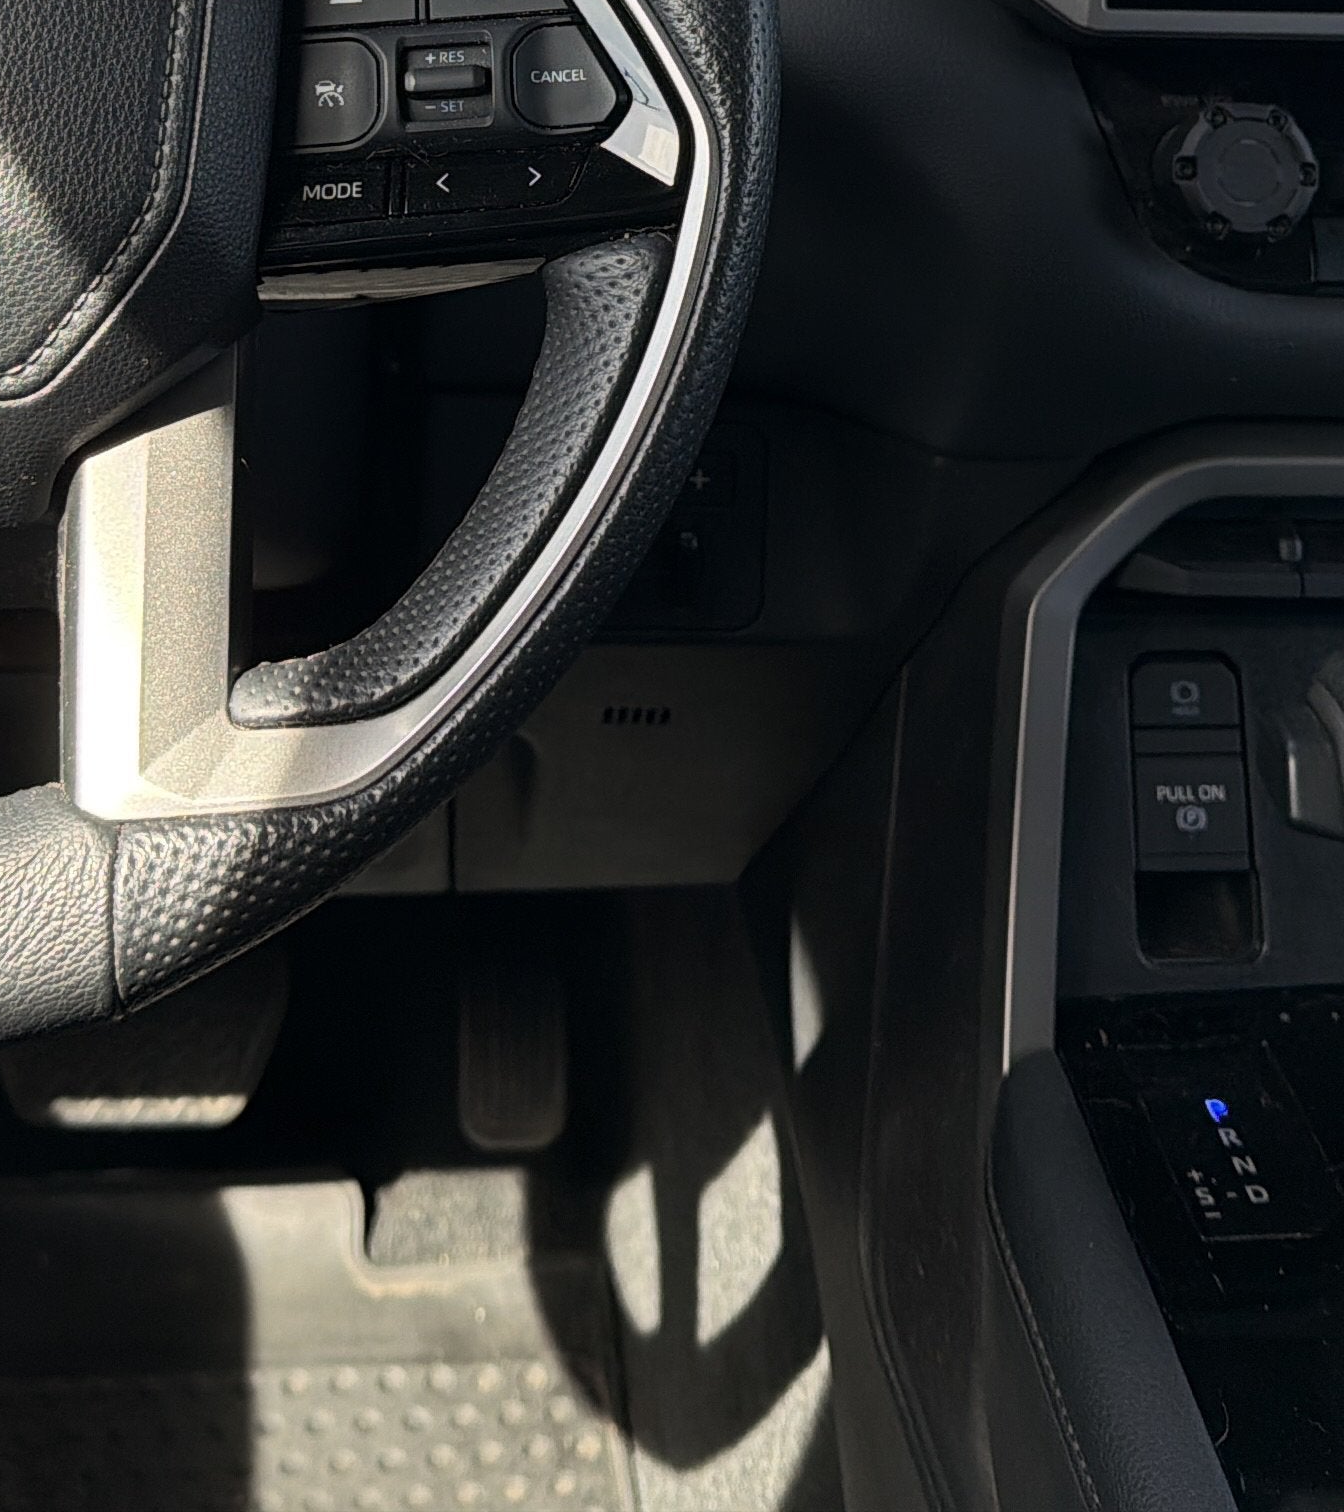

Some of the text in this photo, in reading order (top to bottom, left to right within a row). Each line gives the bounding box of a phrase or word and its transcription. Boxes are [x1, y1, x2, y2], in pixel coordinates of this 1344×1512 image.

[439, 50, 465, 65] RES
[530, 68, 587, 84] CANCEL
[440, 99, 465, 114] SET
[302, 181, 363, 201] MODE
[1156, 784, 1226, 802] PULL ON
[1218, 1127, 1244, 1148] R
[1231, 1155, 1257, 1176] N
[1194, 1187, 1216, 1207] S
[1245, 1184, 1270, 1204] D
